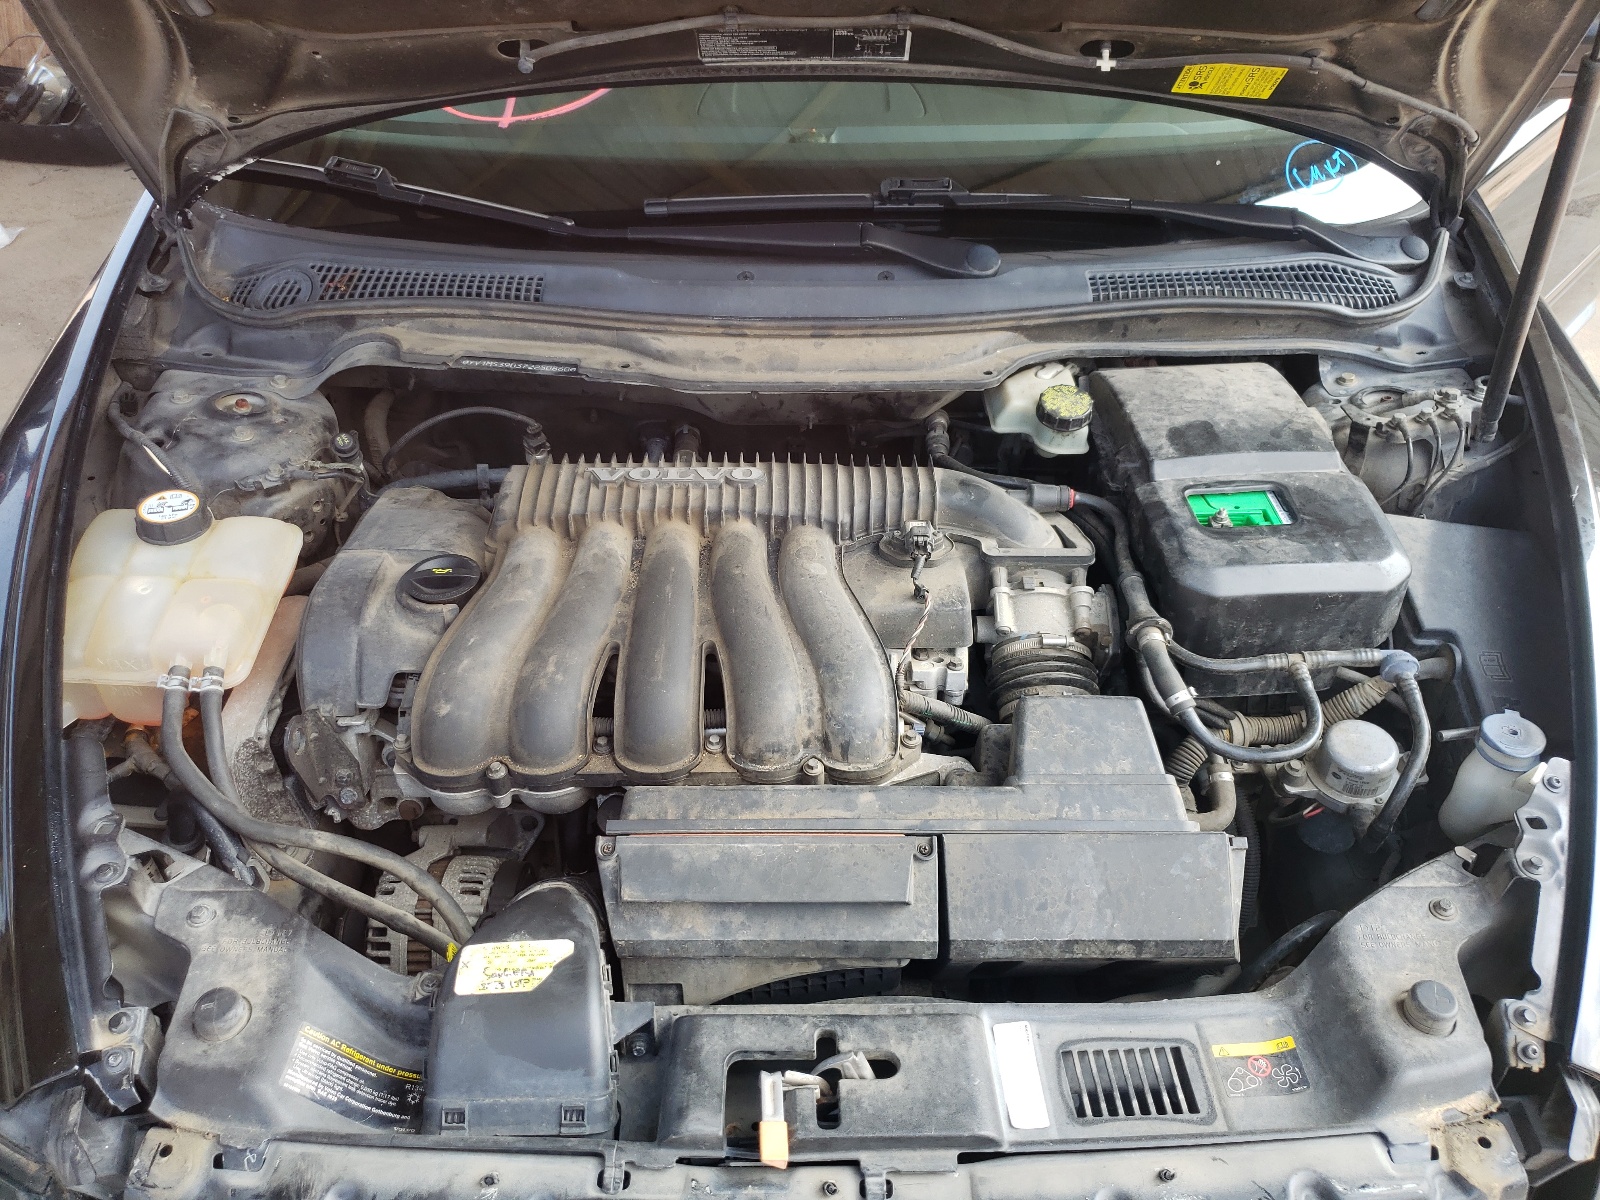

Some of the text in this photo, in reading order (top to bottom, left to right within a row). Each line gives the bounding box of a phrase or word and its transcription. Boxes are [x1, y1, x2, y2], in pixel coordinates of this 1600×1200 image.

[1194, 65, 1208, 81] SRS
[1244, 67, 1260, 83] SRS
[585, 467, 763, 481] VOLVO
[304, 1024, 329, 1043] Caution
[330, 1038, 340, 1048] AC
[340, 1043, 375, 1066] Refrigerant
[376, 1061, 395, 1074] under
[405, 1082, 425, 1092] R134
